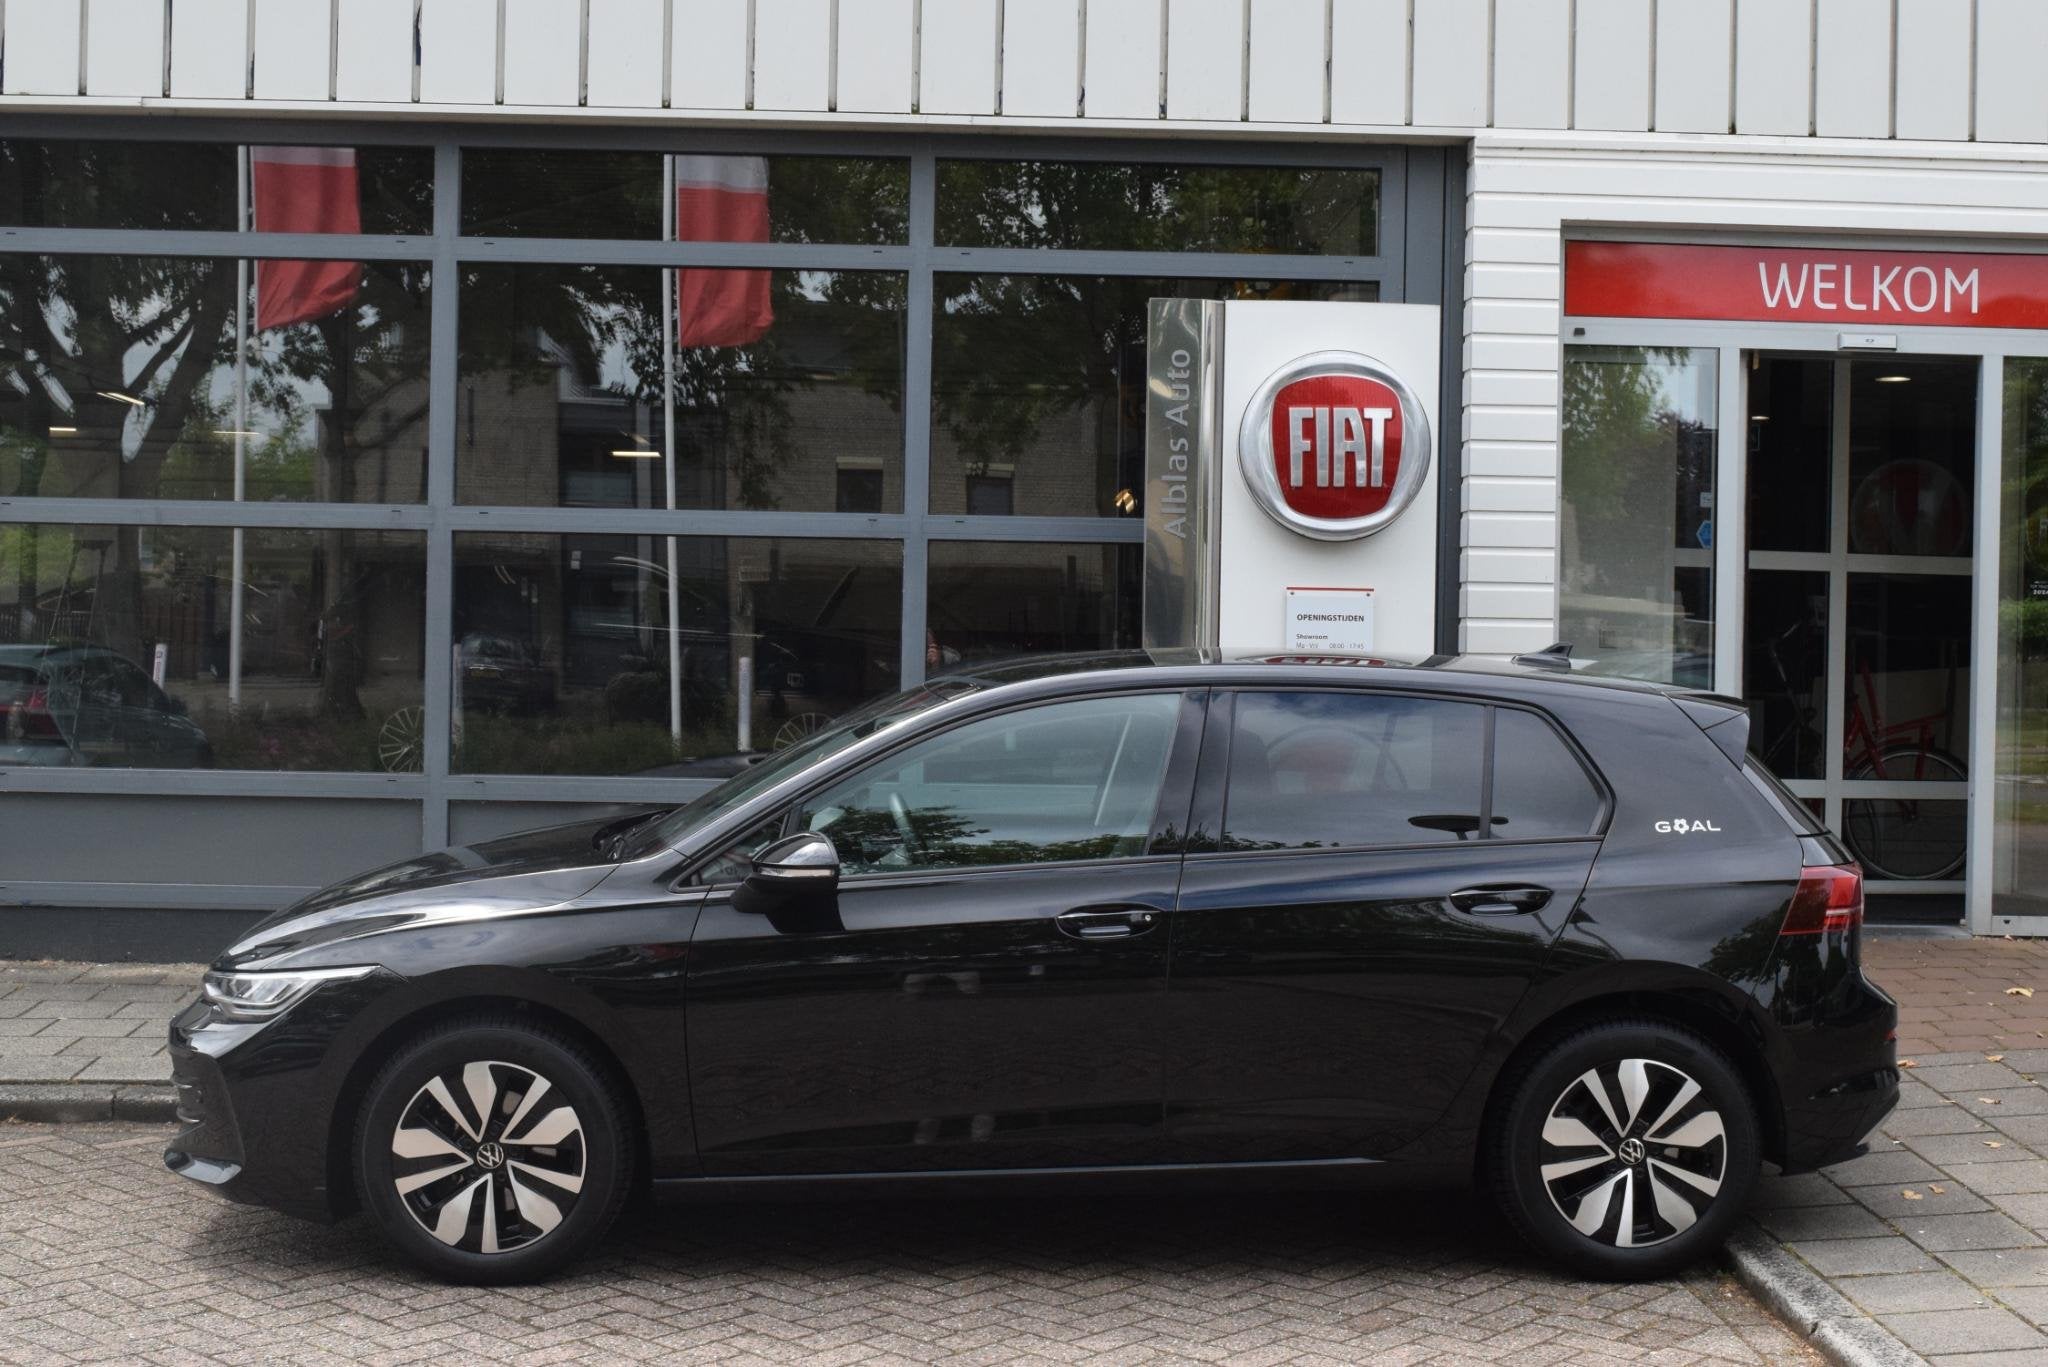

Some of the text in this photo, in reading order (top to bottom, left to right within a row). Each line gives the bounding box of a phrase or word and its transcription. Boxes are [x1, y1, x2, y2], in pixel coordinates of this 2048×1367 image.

[1758, 262, 1979, 314] WELKOM
[1162, 349, 1190, 539] Alblas Auto
[1288, 406, 1393, 488] FIAT
[1296, 614, 1365, 622] OPENINGSTIJDEN
[1654, 818, 1721, 835] GOAL
